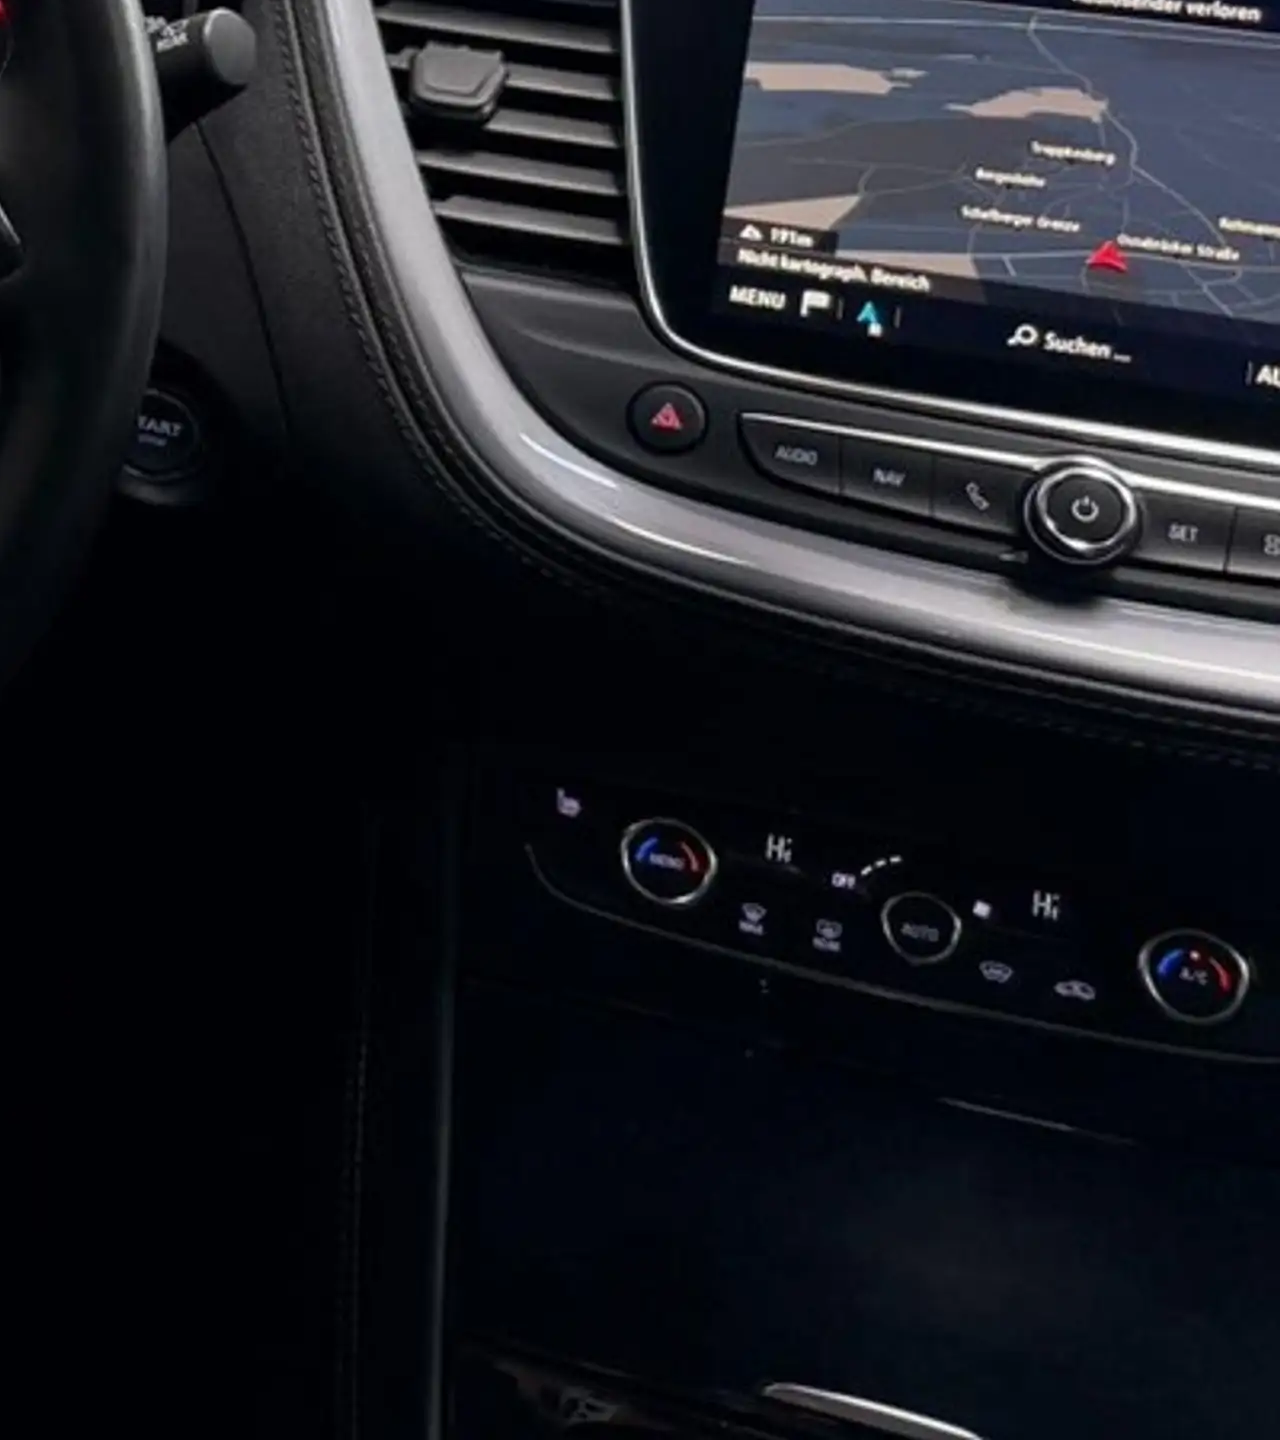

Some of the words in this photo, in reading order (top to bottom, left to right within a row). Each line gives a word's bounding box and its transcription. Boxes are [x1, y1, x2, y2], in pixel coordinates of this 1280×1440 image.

[736, 248, 779, 269] Nicht
[869, 266, 932, 293] Bereich
[728, 284, 787, 311] MENU
[774, 444, 819, 466] AUDIO
[872, 466, 907, 488] NAV
